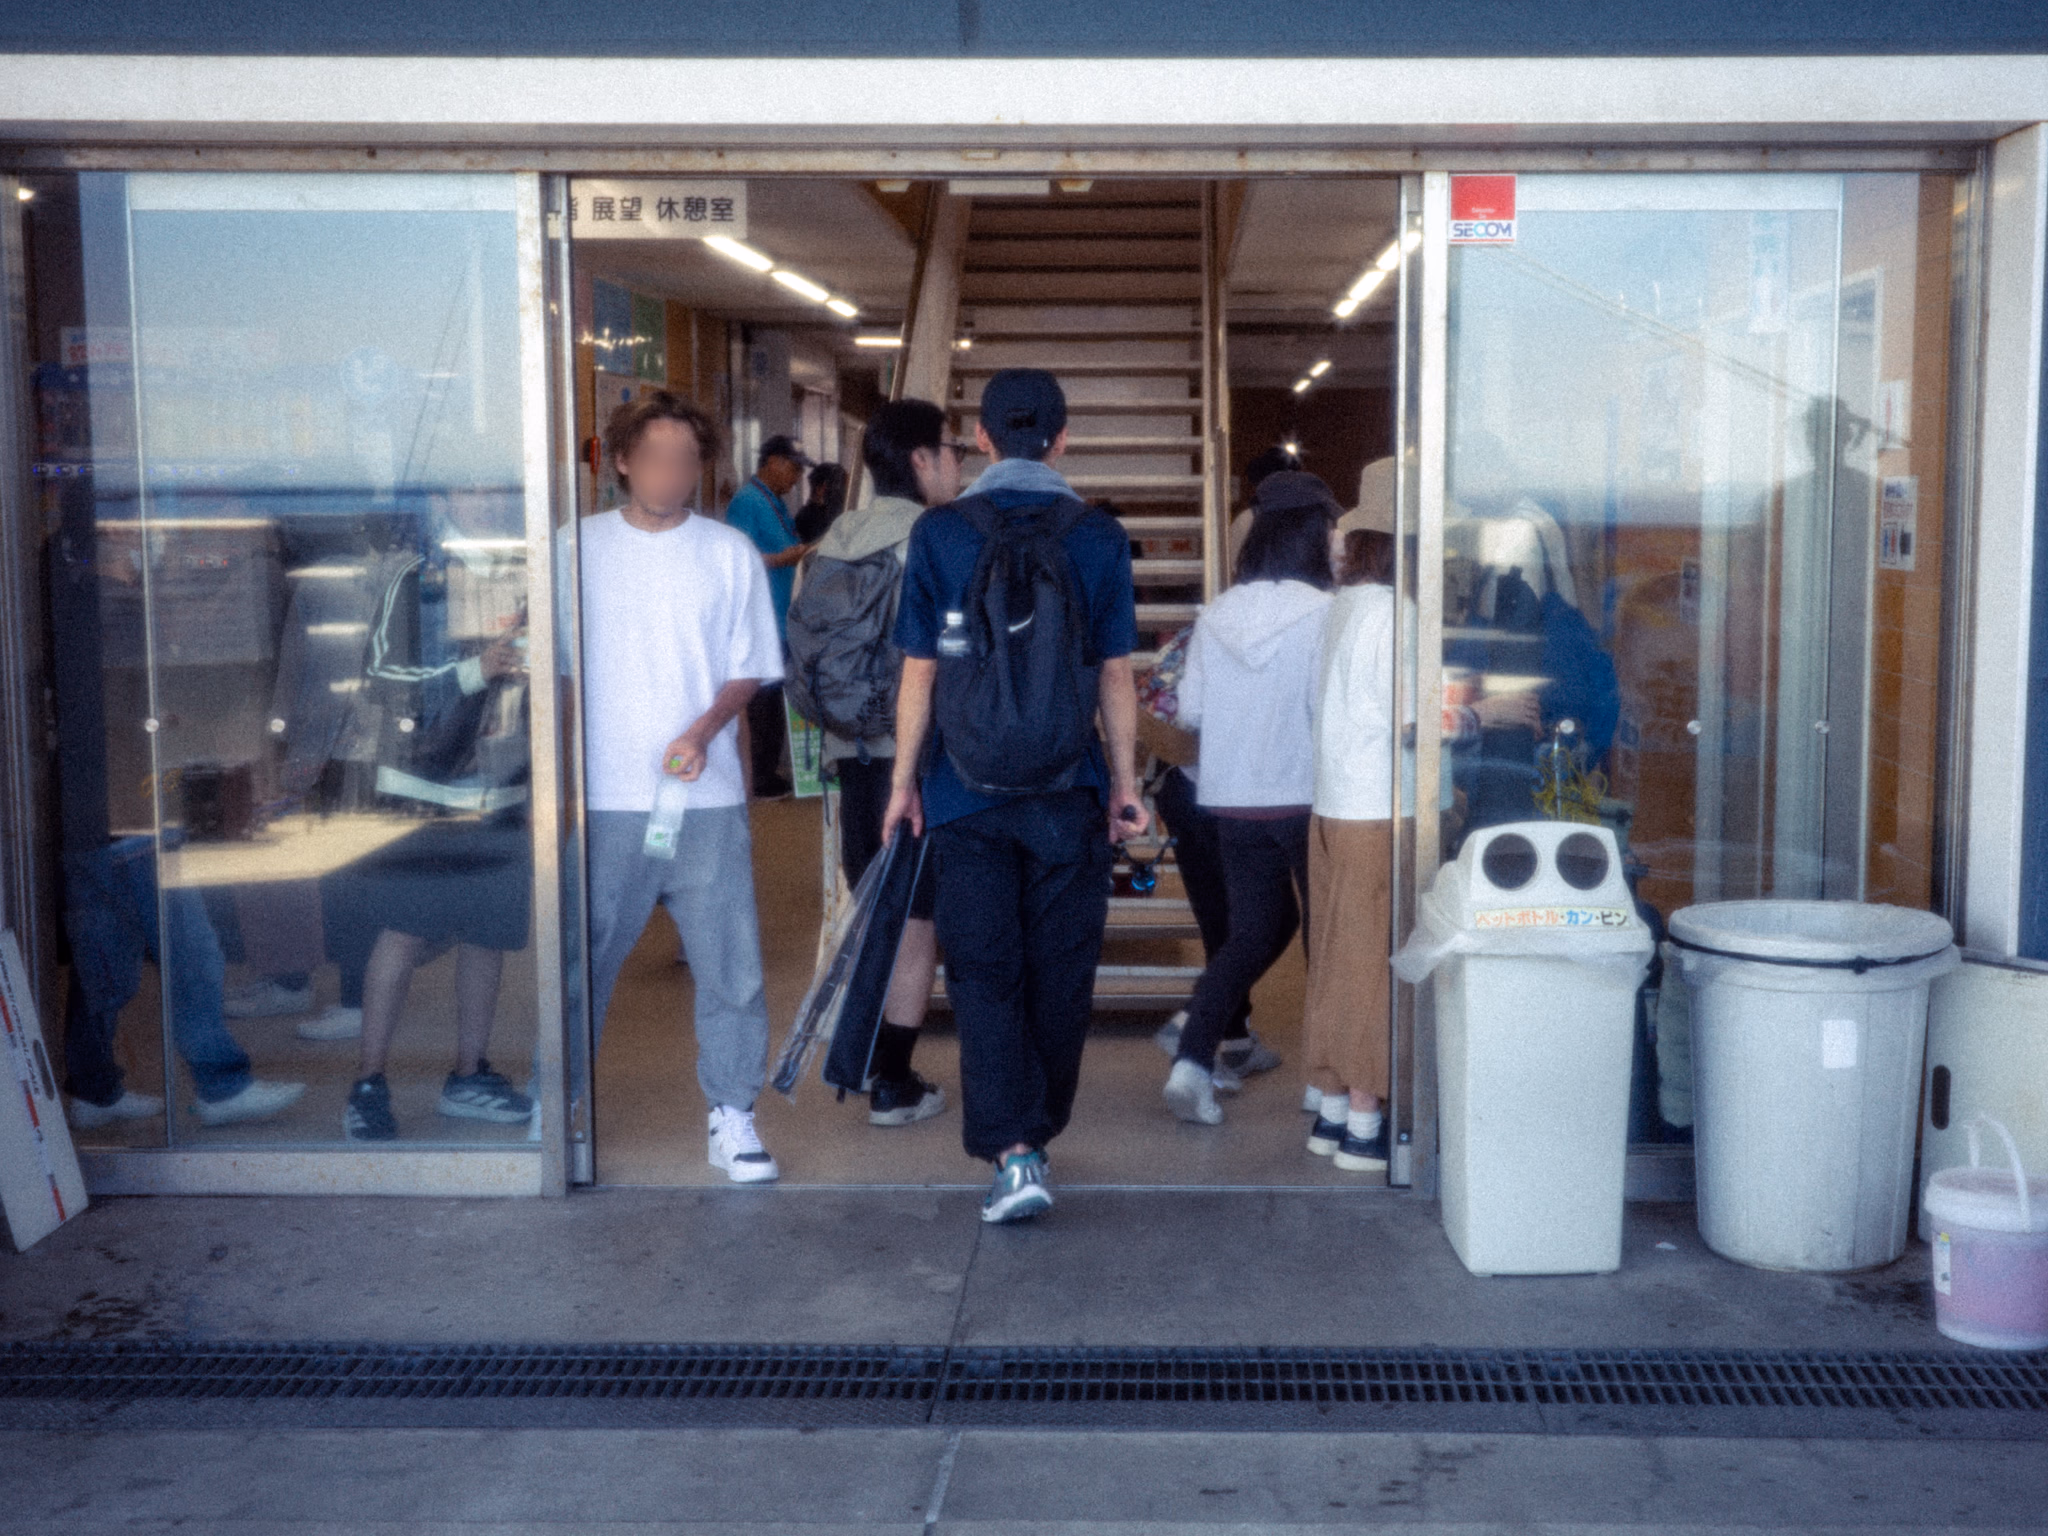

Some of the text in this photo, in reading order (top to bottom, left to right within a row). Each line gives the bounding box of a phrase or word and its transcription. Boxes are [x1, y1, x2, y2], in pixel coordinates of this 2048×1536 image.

[592, 196, 643, 222] 展望
[655, 196, 736, 222] 休憩室
[1453, 222, 1513, 237] SECOM
